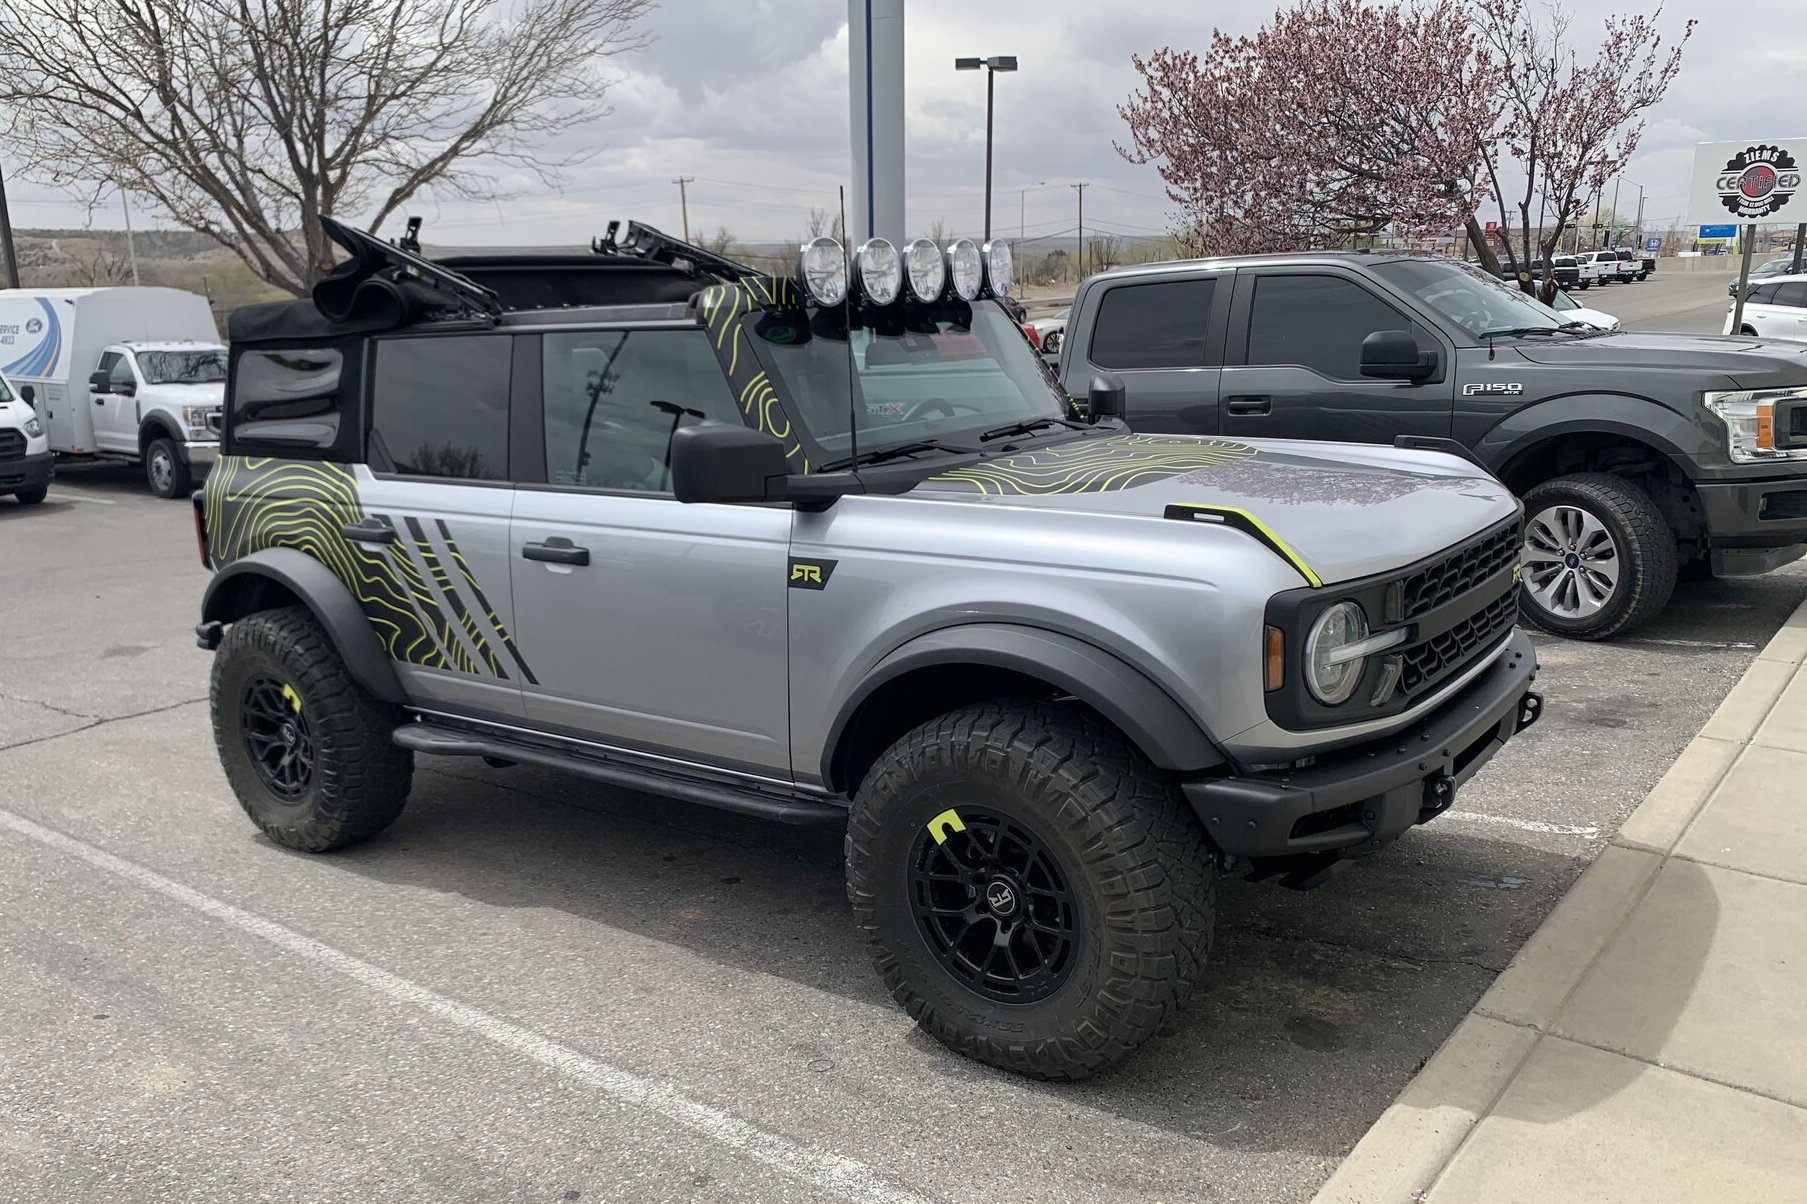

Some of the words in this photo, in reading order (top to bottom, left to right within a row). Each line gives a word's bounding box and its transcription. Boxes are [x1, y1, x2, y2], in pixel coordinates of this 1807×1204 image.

[1744, 149, 1780, 163] ZIEMS
[1716, 174, 1801, 191] CERTIFIED
[1738, 204, 1771, 215] WARRANTY
[0, 325, 20, 334] ERVICE
